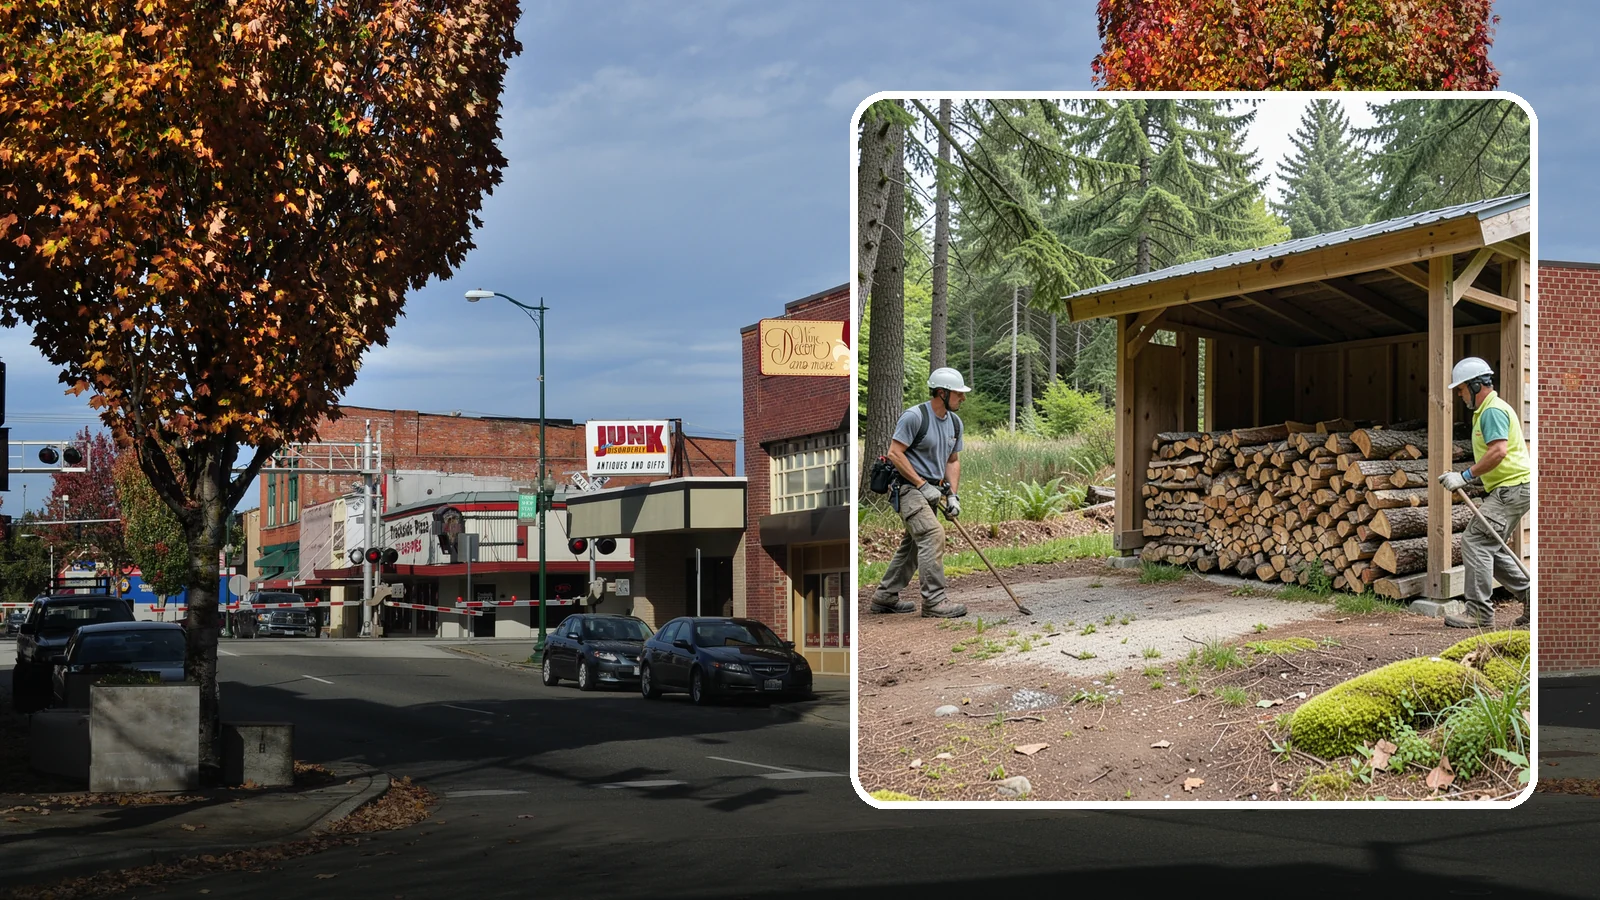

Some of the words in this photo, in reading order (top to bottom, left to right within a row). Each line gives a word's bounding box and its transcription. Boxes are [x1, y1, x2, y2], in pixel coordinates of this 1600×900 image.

[595, 425, 665, 457] JUNK
[607, 446, 645, 454] DISORDERLY
[597, 461, 628, 470] ANTIQUES
[631, 461, 643, 470] AND
[647, 461, 665, 470] GIFTS
[390, 521, 413, 540] Trackside
[414, 519, 429, 535] Pizza
